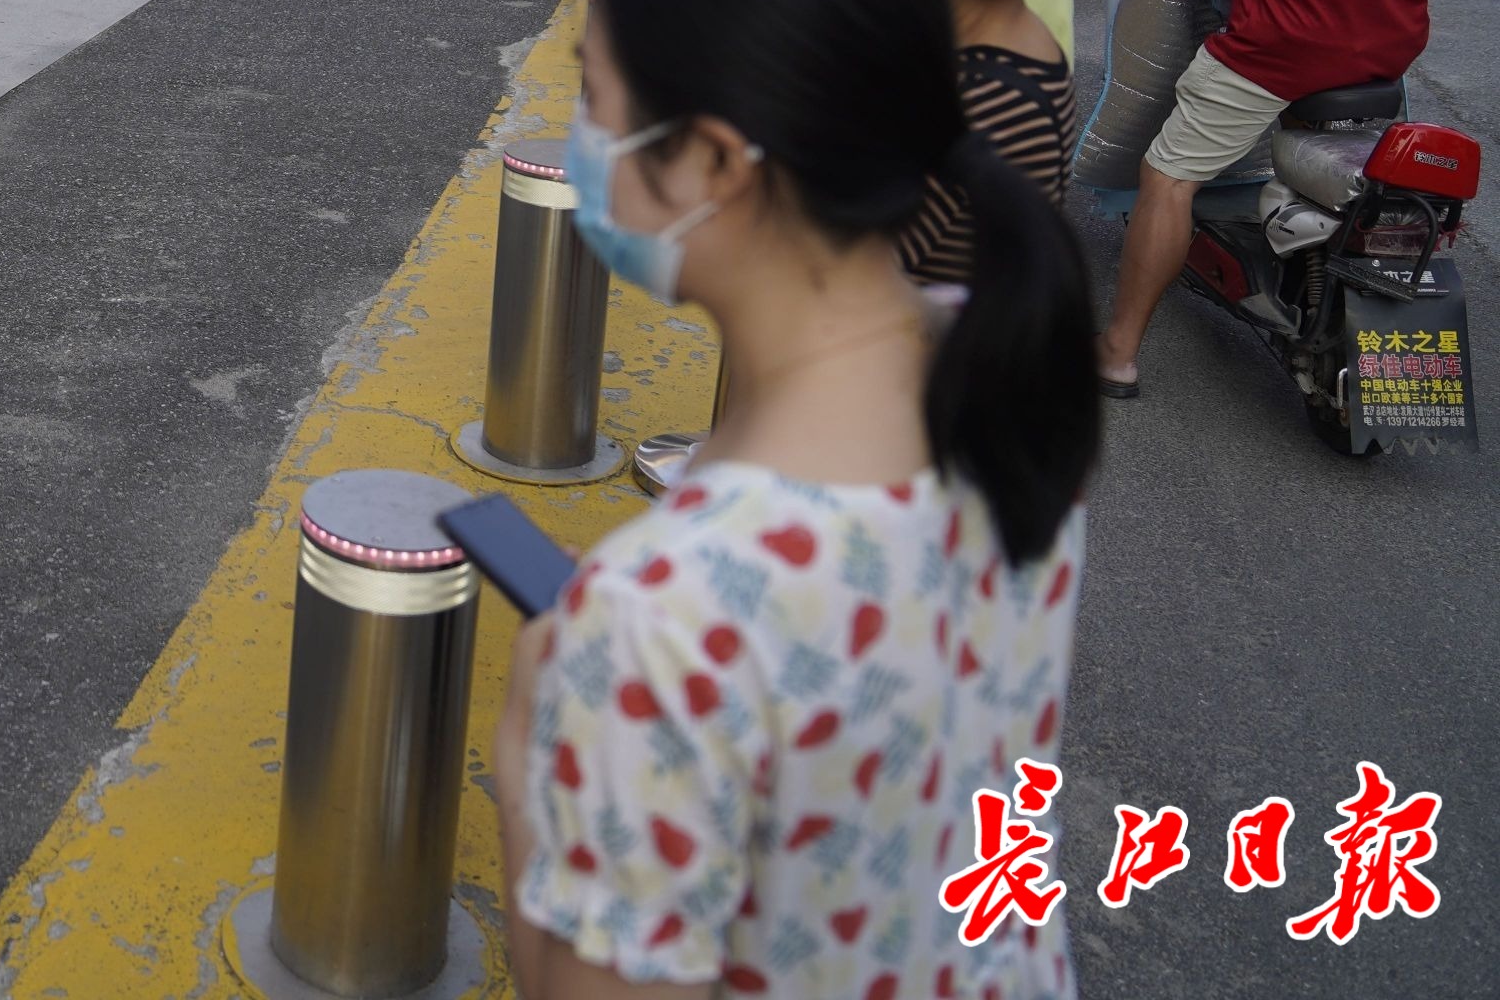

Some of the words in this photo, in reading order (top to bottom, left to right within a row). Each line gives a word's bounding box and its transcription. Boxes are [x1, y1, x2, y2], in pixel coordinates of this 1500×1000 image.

[1357, 330, 1461, 353] 铃木之星
[1358, 354, 1463, 379] 绿佳电动车
[1361, 379, 1464, 392] 中国电动车十强企业
[1361, 393, 1465, 405] 出口欧美等三十多个国家
